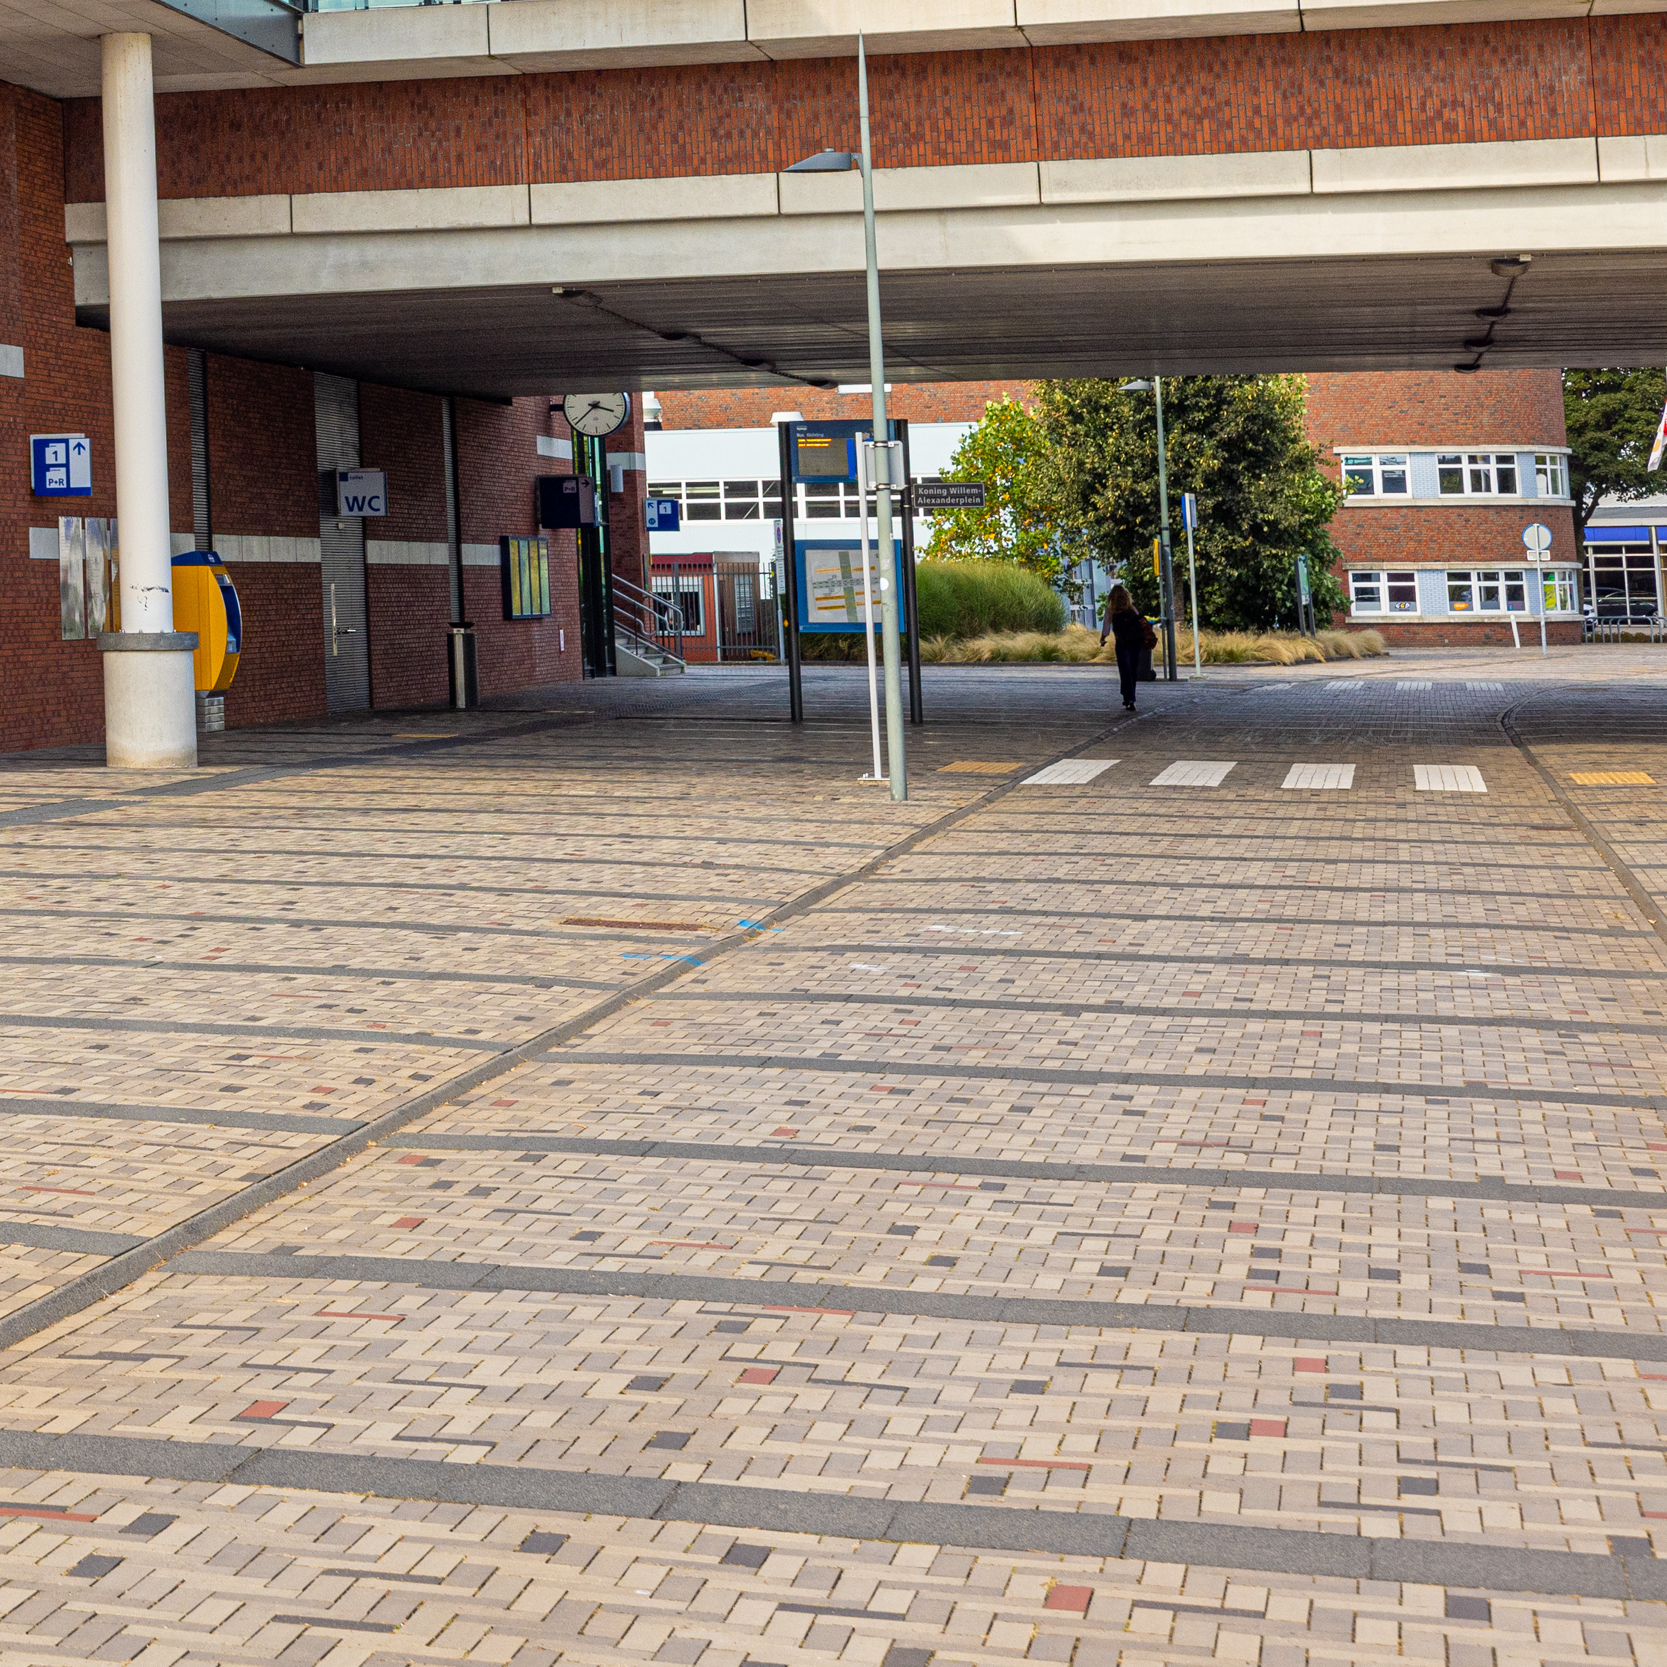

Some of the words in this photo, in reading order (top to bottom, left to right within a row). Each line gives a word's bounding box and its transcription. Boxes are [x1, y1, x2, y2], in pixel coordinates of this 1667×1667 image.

[52, 450, 58, 462] 1
[48, 478, 64, 486] P+R
[918, 487, 947, 496] Koning
[344, 496, 380, 512] WC
[917, 496, 980, 505] Alexanderplein
